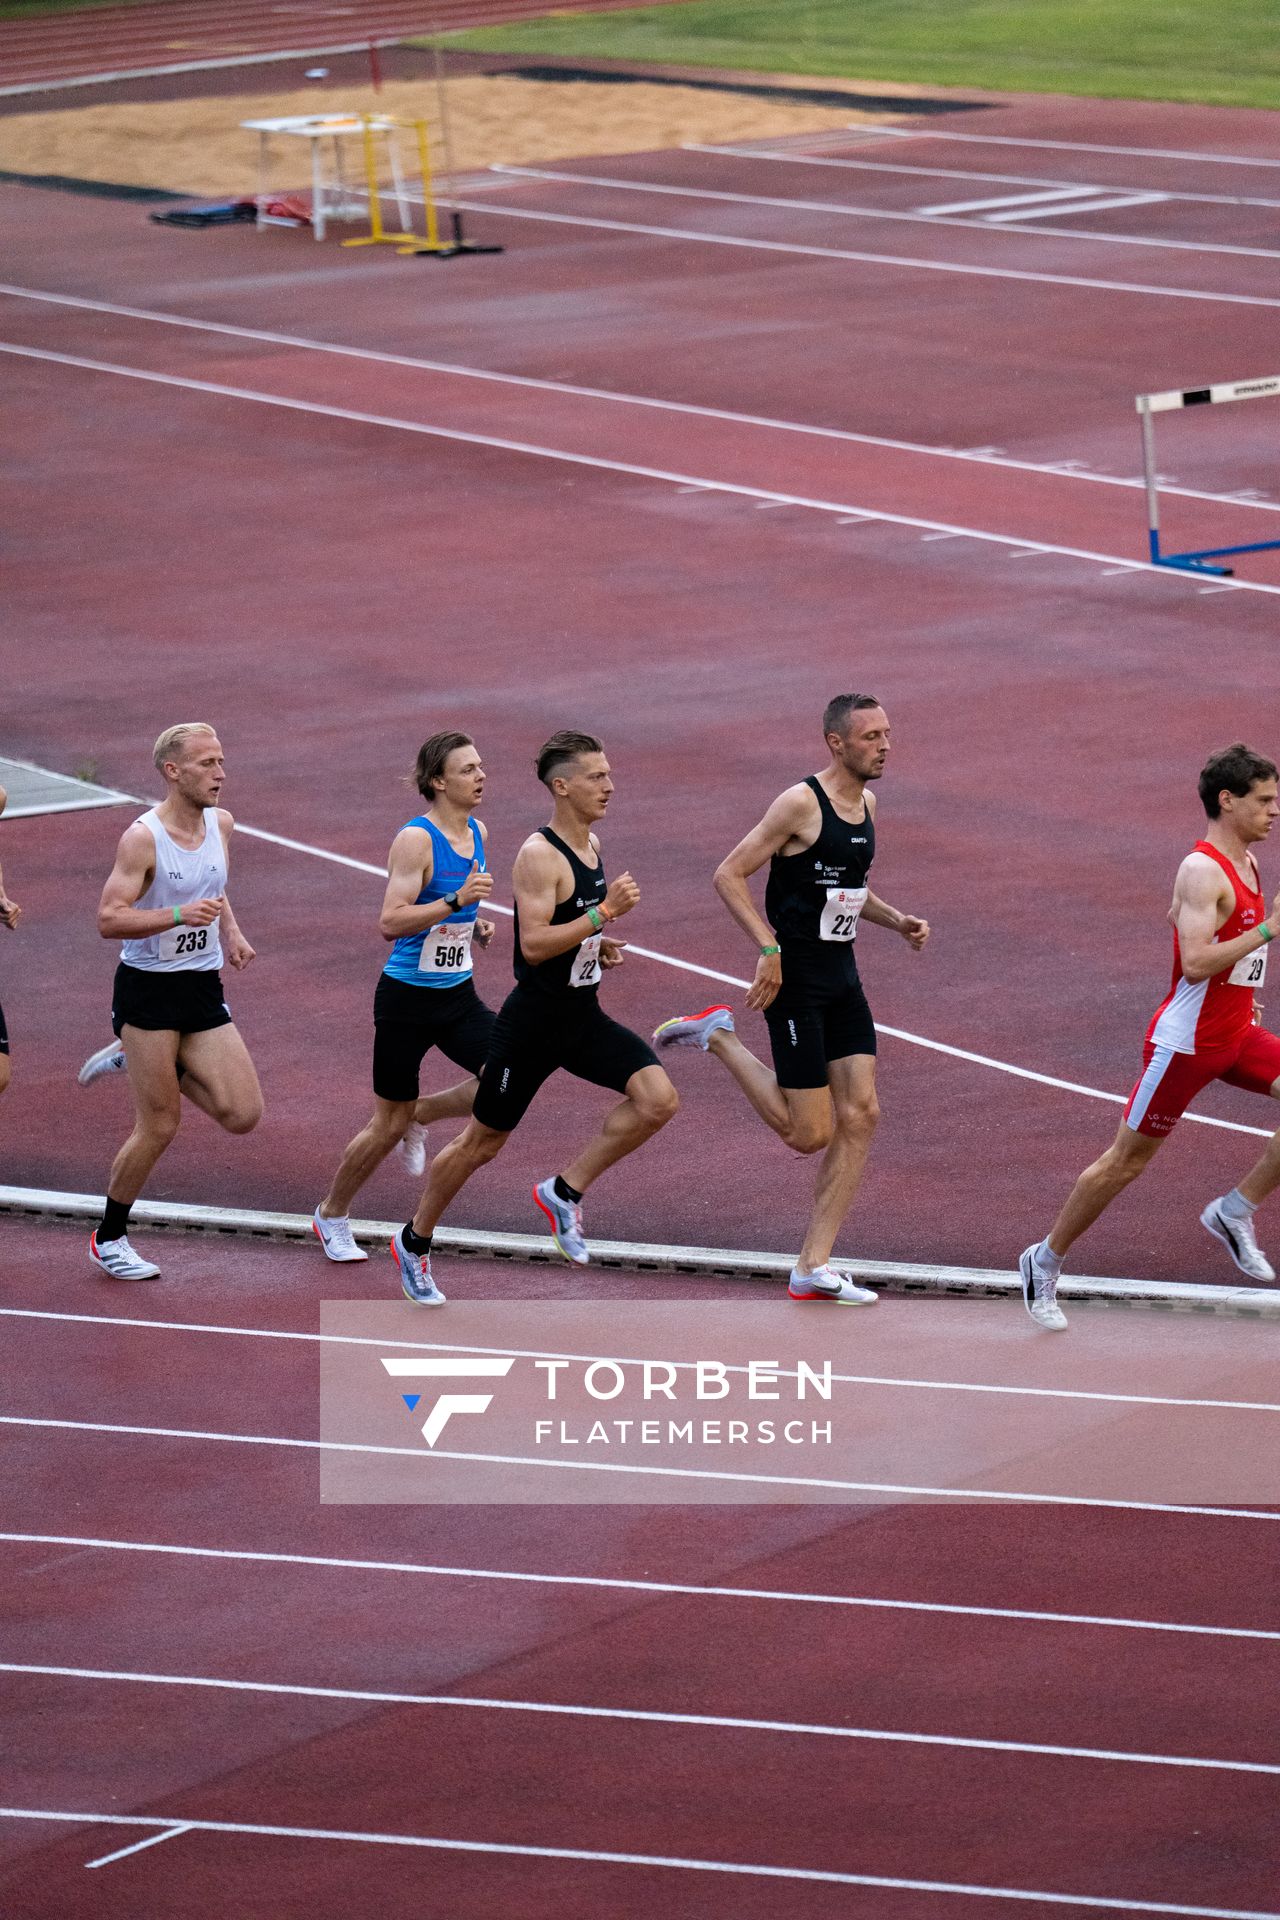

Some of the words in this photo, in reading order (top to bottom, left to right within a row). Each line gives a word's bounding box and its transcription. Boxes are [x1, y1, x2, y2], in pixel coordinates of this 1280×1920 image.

[168, 872, 183, 880] TVL
[175, 929, 208, 954] 233
[434, 945, 465, 967] 596
[501, 1067, 510, 1089] CRAFT
